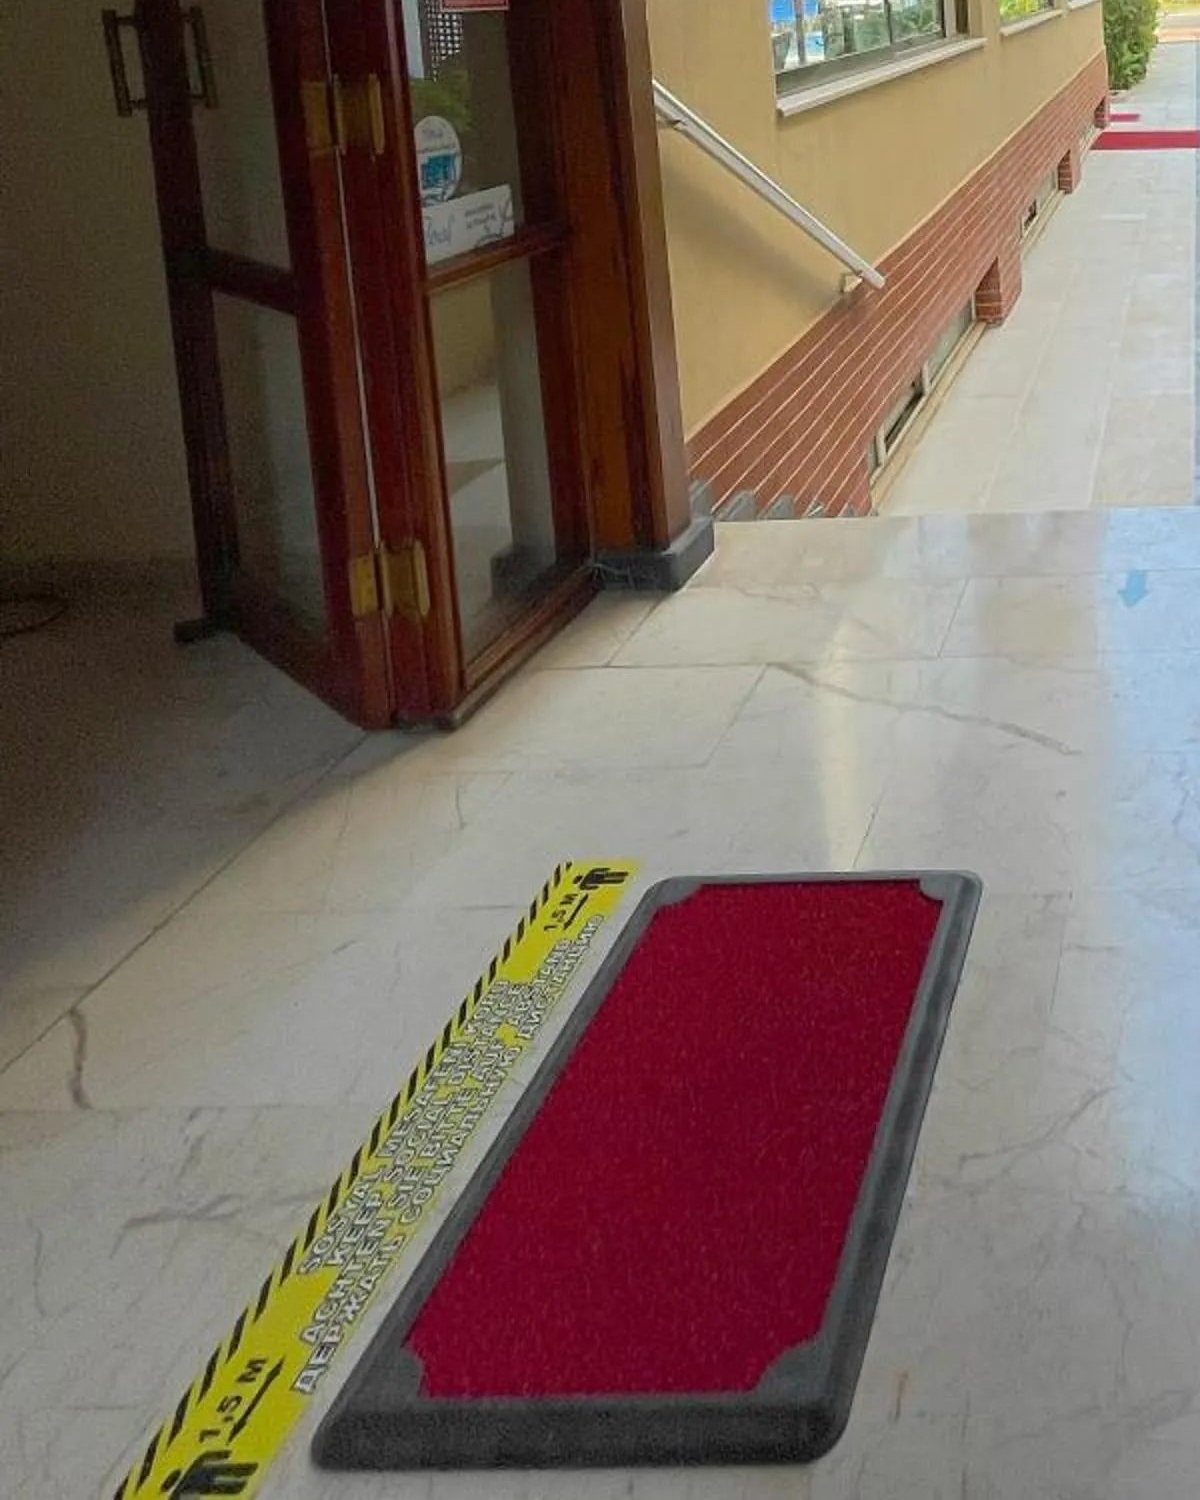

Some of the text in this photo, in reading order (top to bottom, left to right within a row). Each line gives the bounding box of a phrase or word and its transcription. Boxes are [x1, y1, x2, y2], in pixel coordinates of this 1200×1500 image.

[298, 1170, 385, 1274] SOSYAL
[302, 1221, 392, 1343] ACHTEN
[389, 1168, 427, 1206] SIE
[420, 1091, 475, 1156] BITTE
[326, 1193, 388, 1265] KEEP
[382, 1099, 449, 1182] SOCIAL
[291, 1236, 407, 1393] ДЕРЖАТЬ
[199, 1358, 268, 1442] 1,5 M
